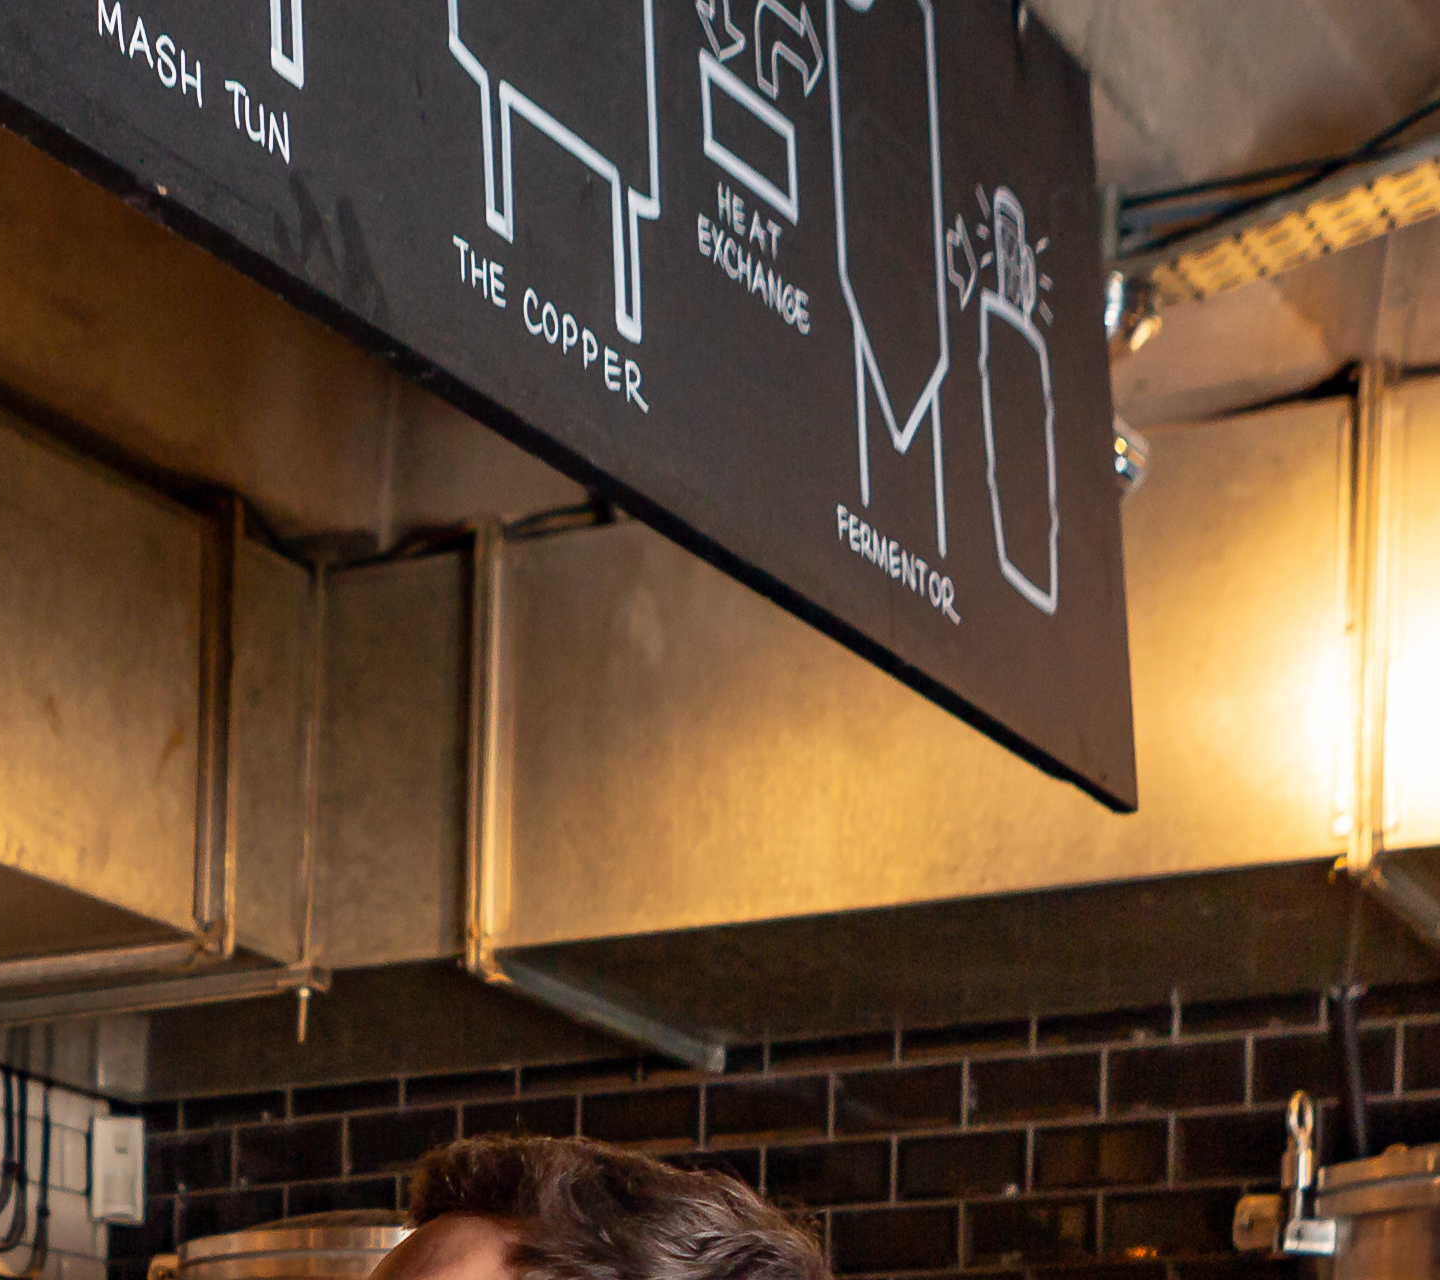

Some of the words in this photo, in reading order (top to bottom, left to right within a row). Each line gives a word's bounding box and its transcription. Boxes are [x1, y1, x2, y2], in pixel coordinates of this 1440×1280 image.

[98, 0, 203, 109] MASH
[224, 79, 290, 165] TUN
[697, 213, 812, 335] EXCHANGE
[717, 181, 783, 261] HEAT
[453, 234, 507, 308] THE
[523, 287, 649, 413] COPPER
[836, 503, 962, 626] FERMENTOR
